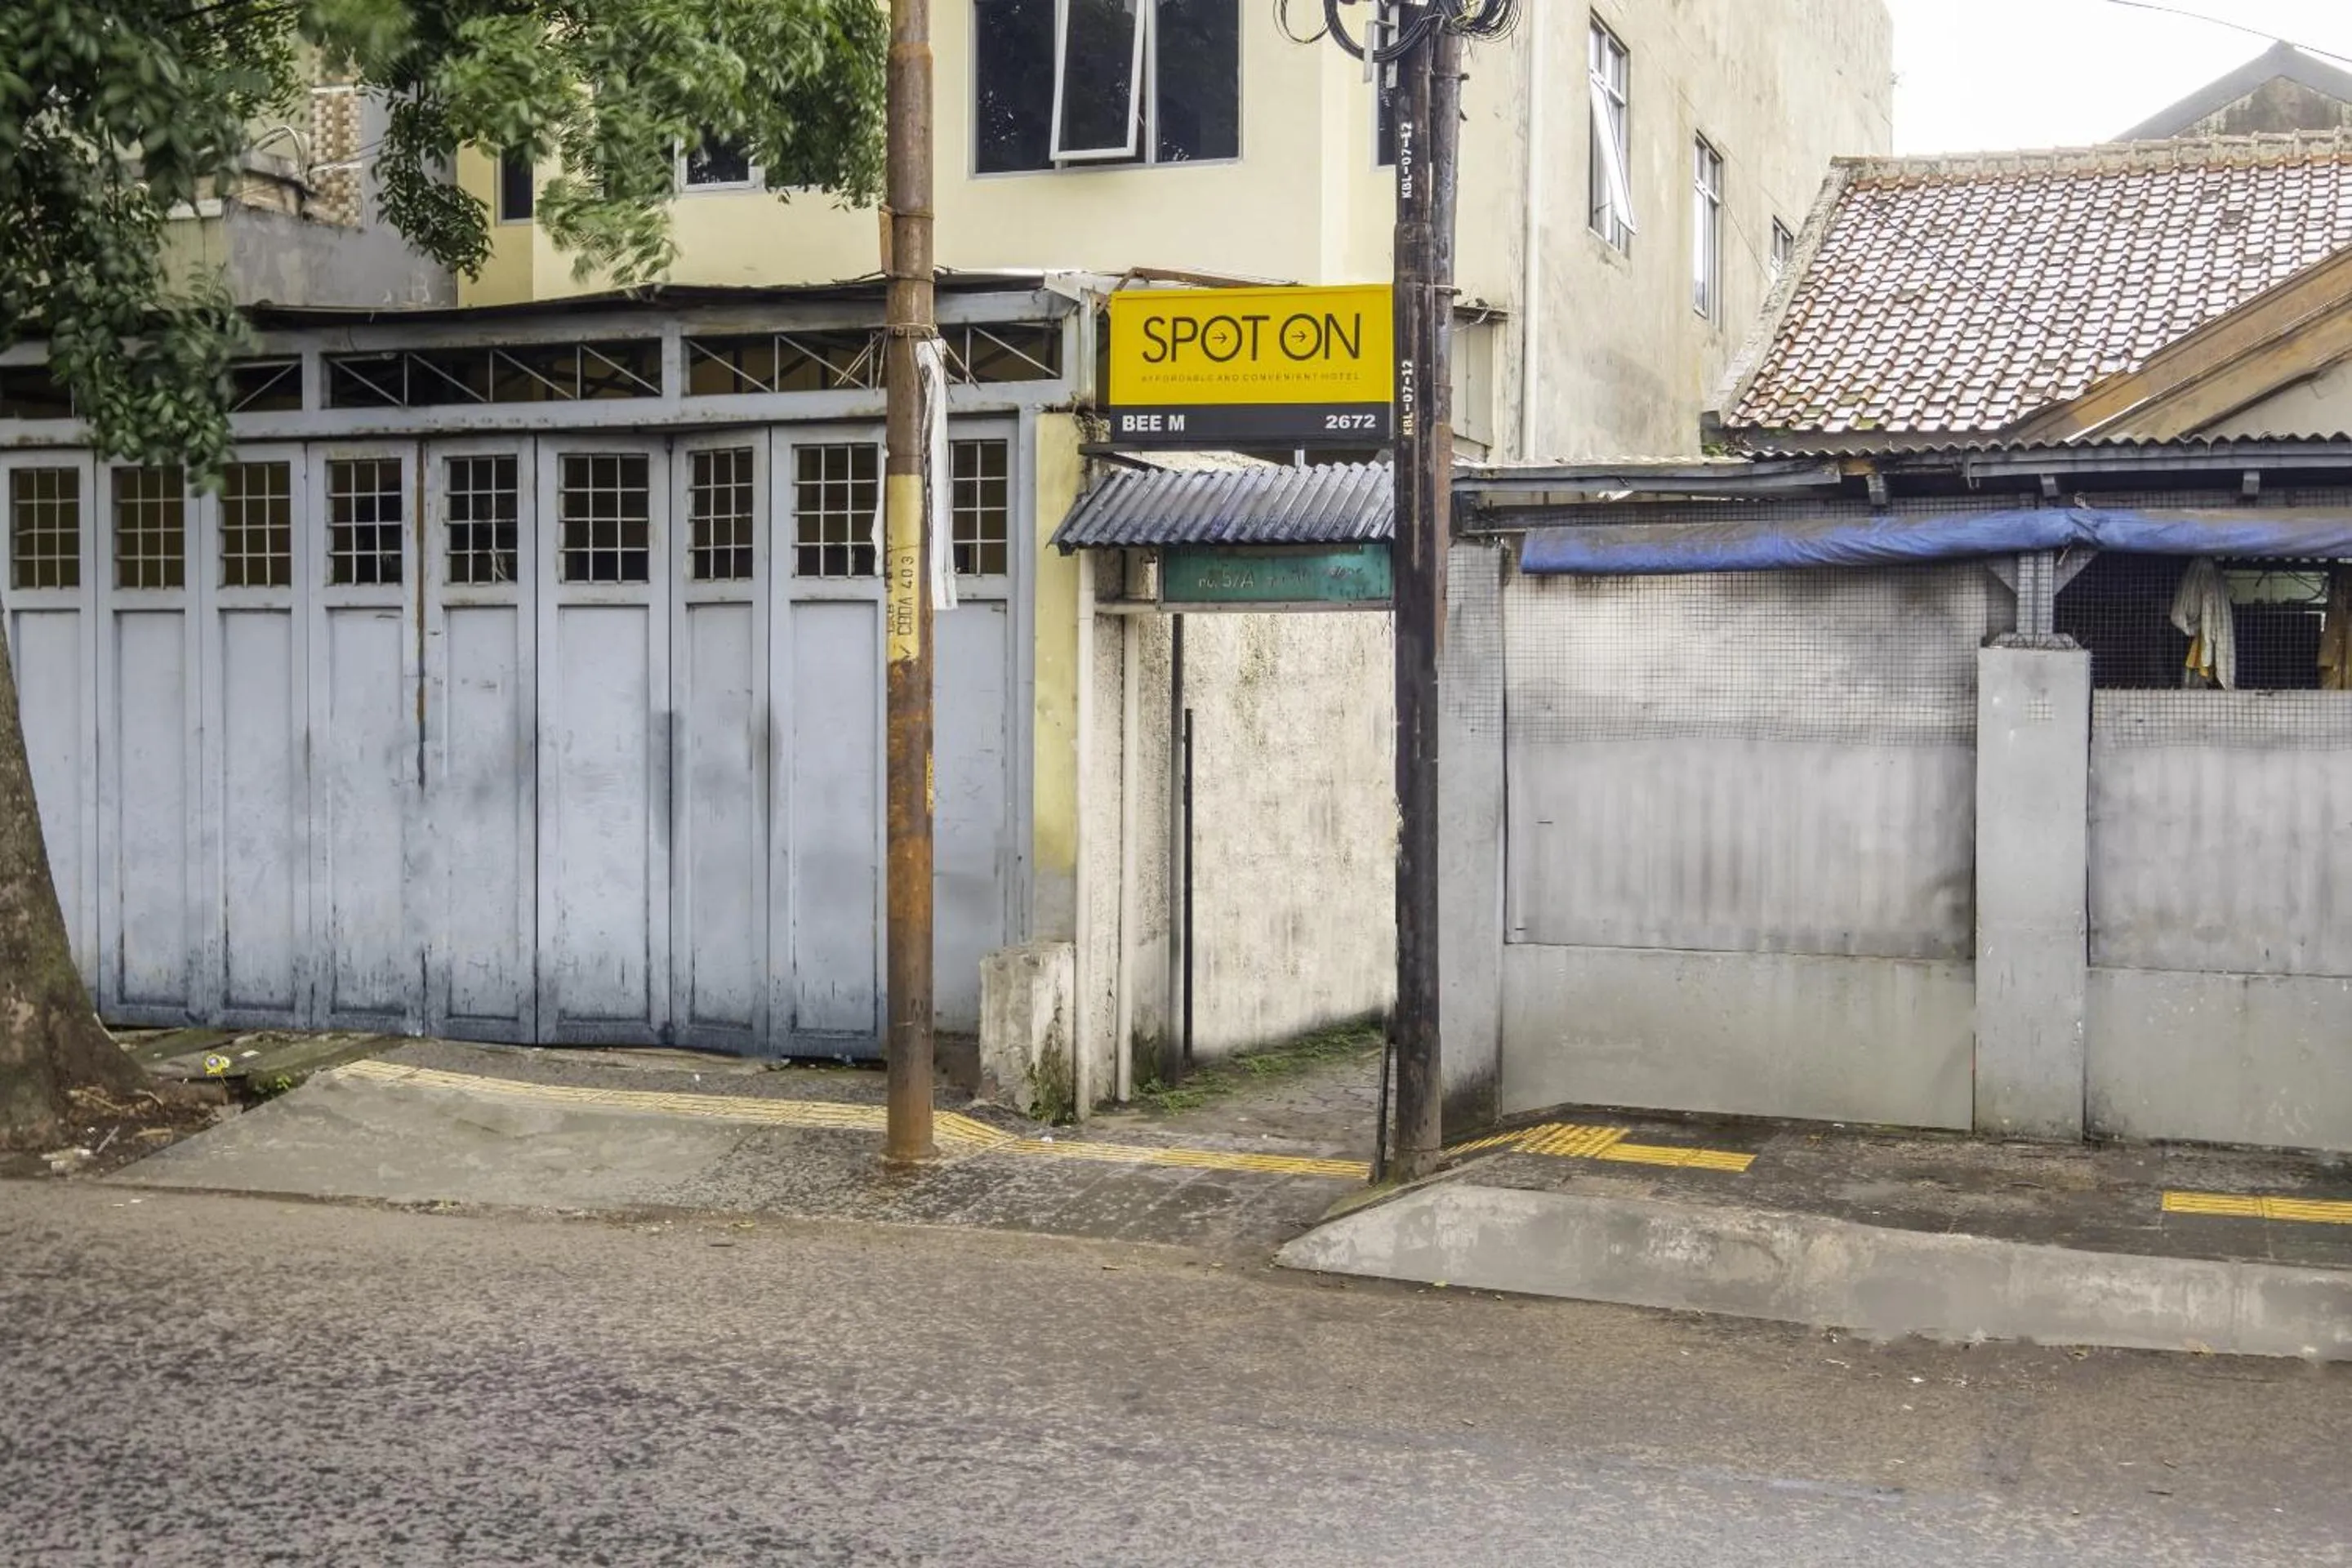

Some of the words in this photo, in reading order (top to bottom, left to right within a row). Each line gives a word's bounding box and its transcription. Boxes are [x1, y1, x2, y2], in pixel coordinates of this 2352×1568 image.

[1400, 121, 1413, 198] KBL-07-12
[1141, 314, 1271, 363] SPOT
[1279, 312, 1361, 361] ON
[1122, 414, 1163, 432] BEE
[1168, 414, 1185, 432] M
[1325, 413, 1376, 430] 2672
